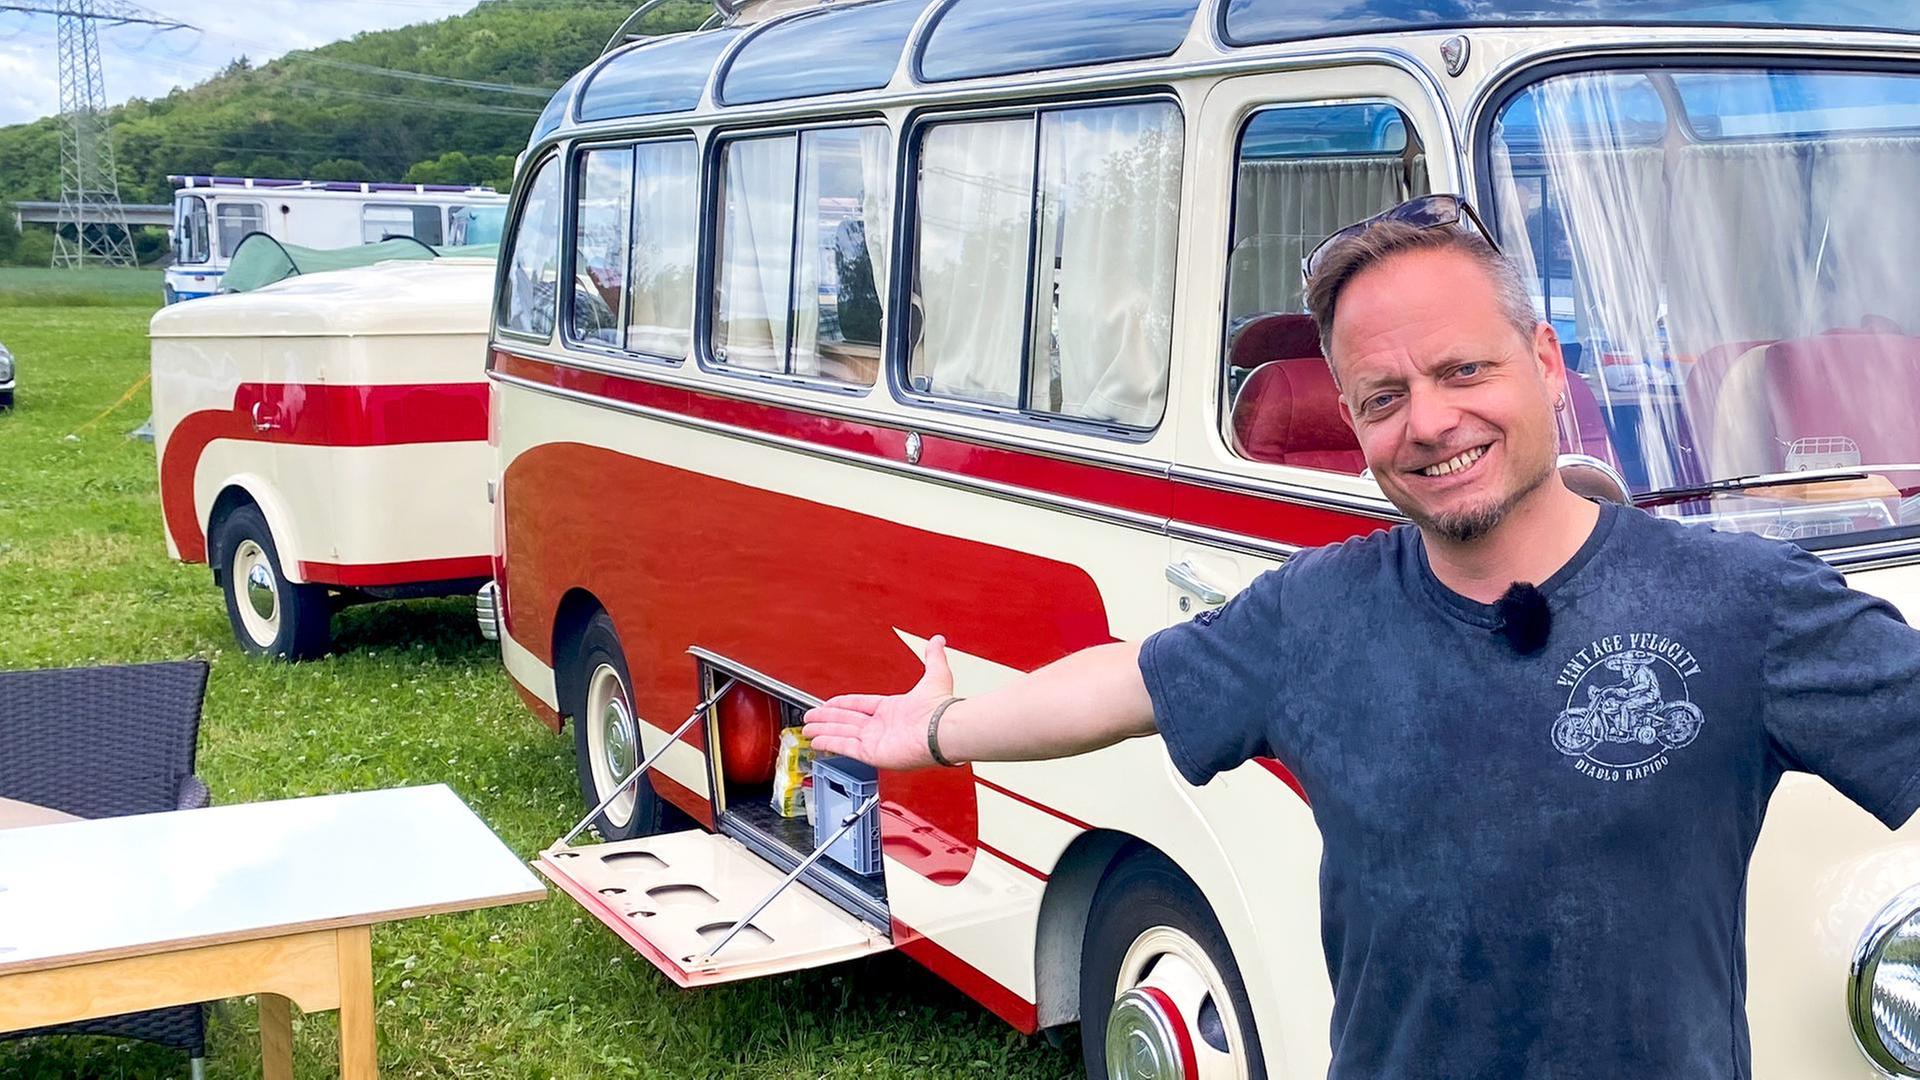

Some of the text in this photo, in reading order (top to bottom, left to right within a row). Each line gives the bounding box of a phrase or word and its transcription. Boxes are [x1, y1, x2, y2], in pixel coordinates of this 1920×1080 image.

[1630, 632, 1702, 677] VELOCITY
[1574, 755, 1669, 782] DIABLO RAPIDO
